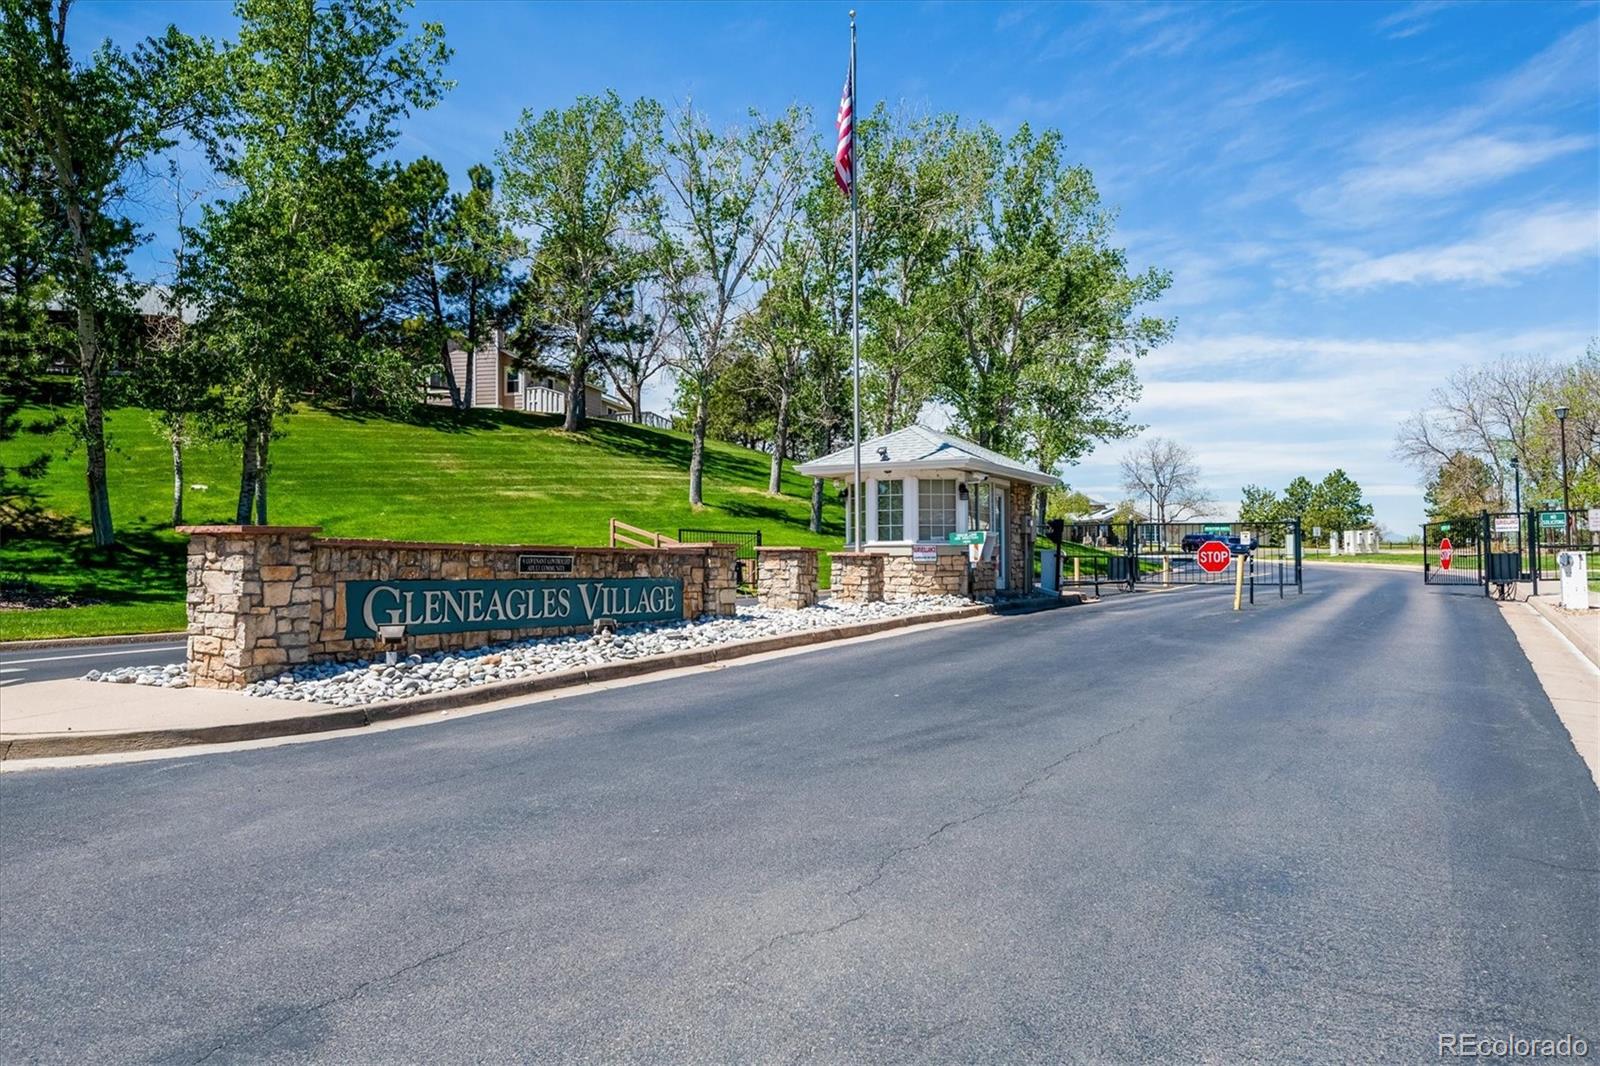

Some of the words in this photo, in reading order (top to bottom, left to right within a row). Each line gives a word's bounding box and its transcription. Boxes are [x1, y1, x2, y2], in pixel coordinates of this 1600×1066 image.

[1200, 551, 1229, 563] STOP
[363, 585, 570, 633] GLENEAGLES
[577, 583, 675, 620] VILLAGE
